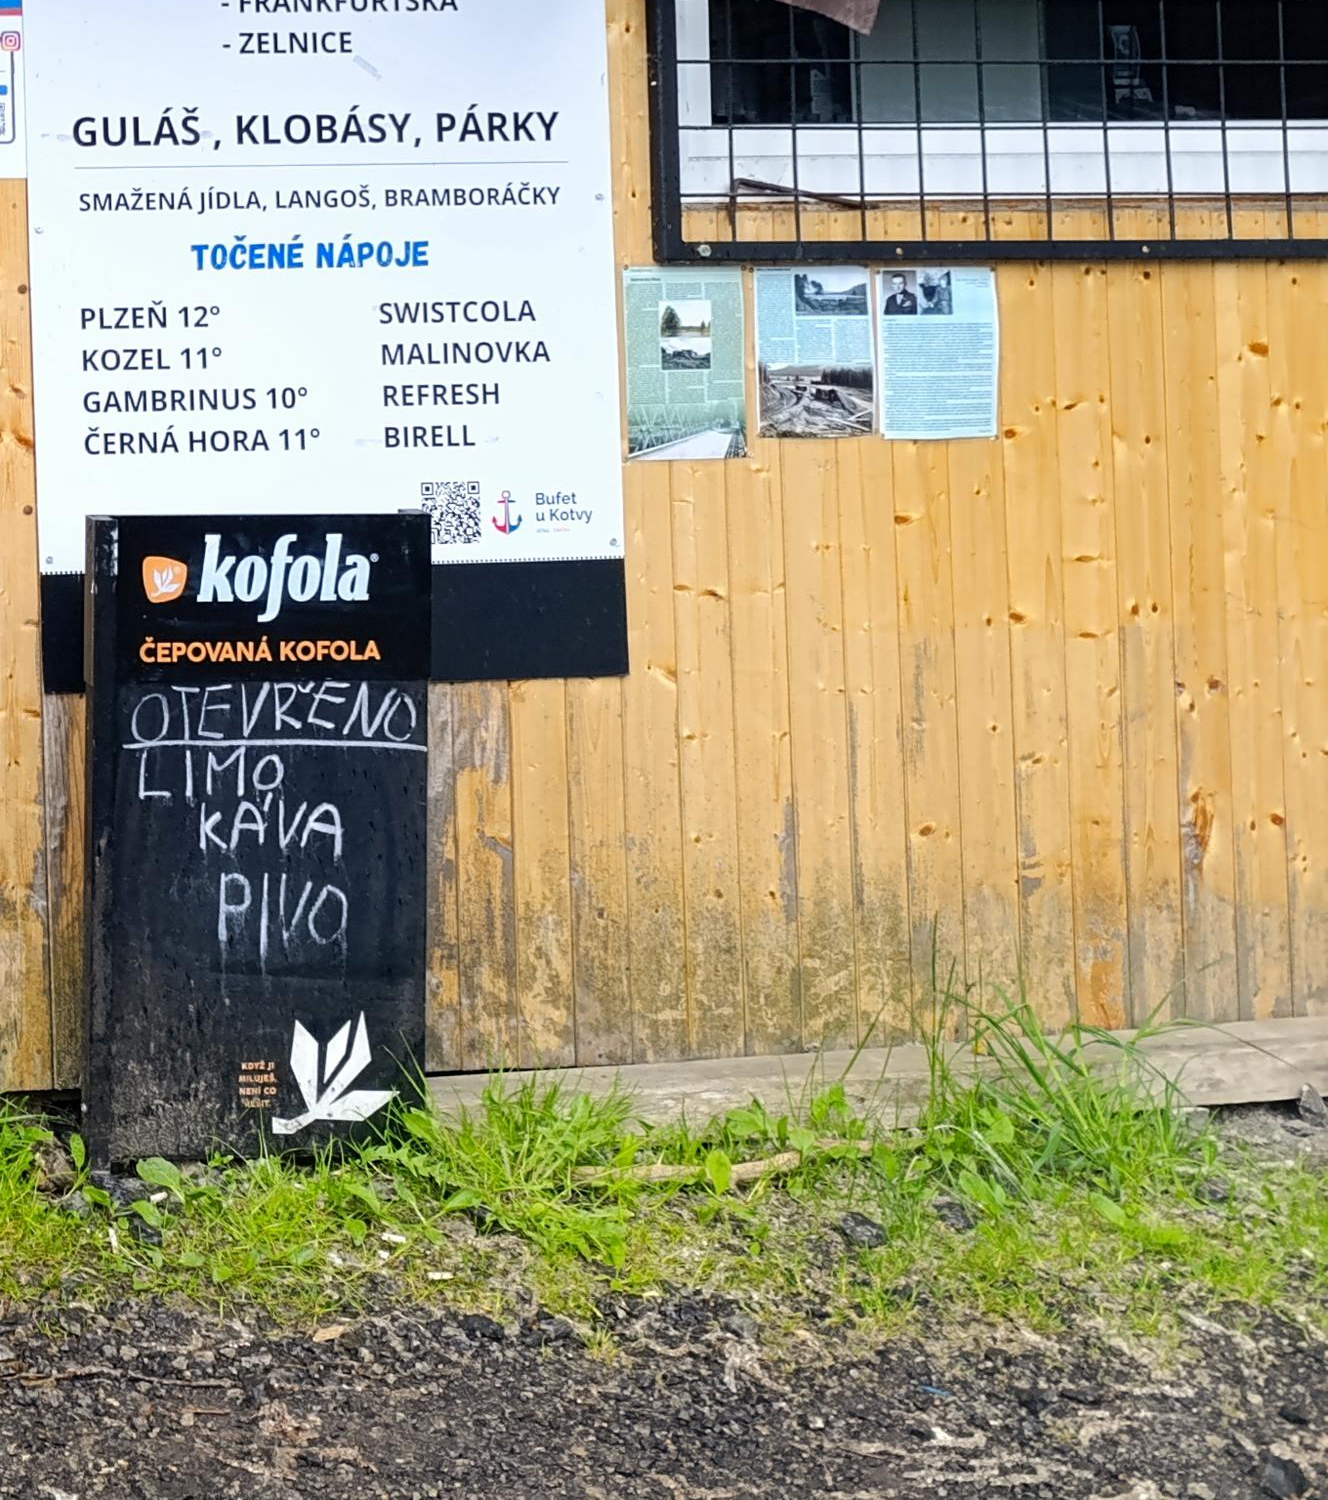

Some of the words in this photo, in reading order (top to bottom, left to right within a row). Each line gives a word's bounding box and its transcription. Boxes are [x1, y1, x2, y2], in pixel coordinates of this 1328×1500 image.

[239, 31, 353, 55] ZELNICE
[235, 104, 423, 149] KLOBÁSY,
[435, 103, 559, 143] PÁRKY
[78, 187, 193, 212] SMAŽENÁ
[198, 186, 268, 215] JÍDLA,
[274, 183, 377, 213] LANGOŠ,
[384, 179, 561, 208] BRAMBORÁČKY
[190, 234, 304, 271] TOČENÉ
[314, 233, 430, 269] NÁPOJE
[80, 300, 168, 330] PLZEŇ
[177, 305, 221, 329] 12°
[378, 299, 536, 325] SWISTCOLA
[81, 347, 171, 372] KOZEL
[179, 346, 223, 370] 11°
[381, 340, 551, 366] MALINOVKA
[82, 387, 257, 414] GAMBRINUS
[265, 385, 308, 410] 10°
[383, 382, 501, 408] REFRESH
[84, 425, 180, 455] ČERNÁ
[188, 428, 270, 453] HORA
[278, 427, 321, 451] 11°
[383, 424, 476, 449] BIRELL
[535, 491, 577, 505] Bufet
[535, 512, 545, 522] u
[549, 508, 593, 524] Kotvy
[196, 532, 371, 623] kofola
[138, 635, 270, 664] ČEPOVANÁ
[279, 639, 382, 663] KOFOLA
[131, 680, 417, 742] OTEVŘENO
[138, 746, 285, 800] LIMO
[198, 791, 344, 862] KÁVA
[217, 871, 349, 956] PIVO
[263, 1086, 277, 1096] CO
